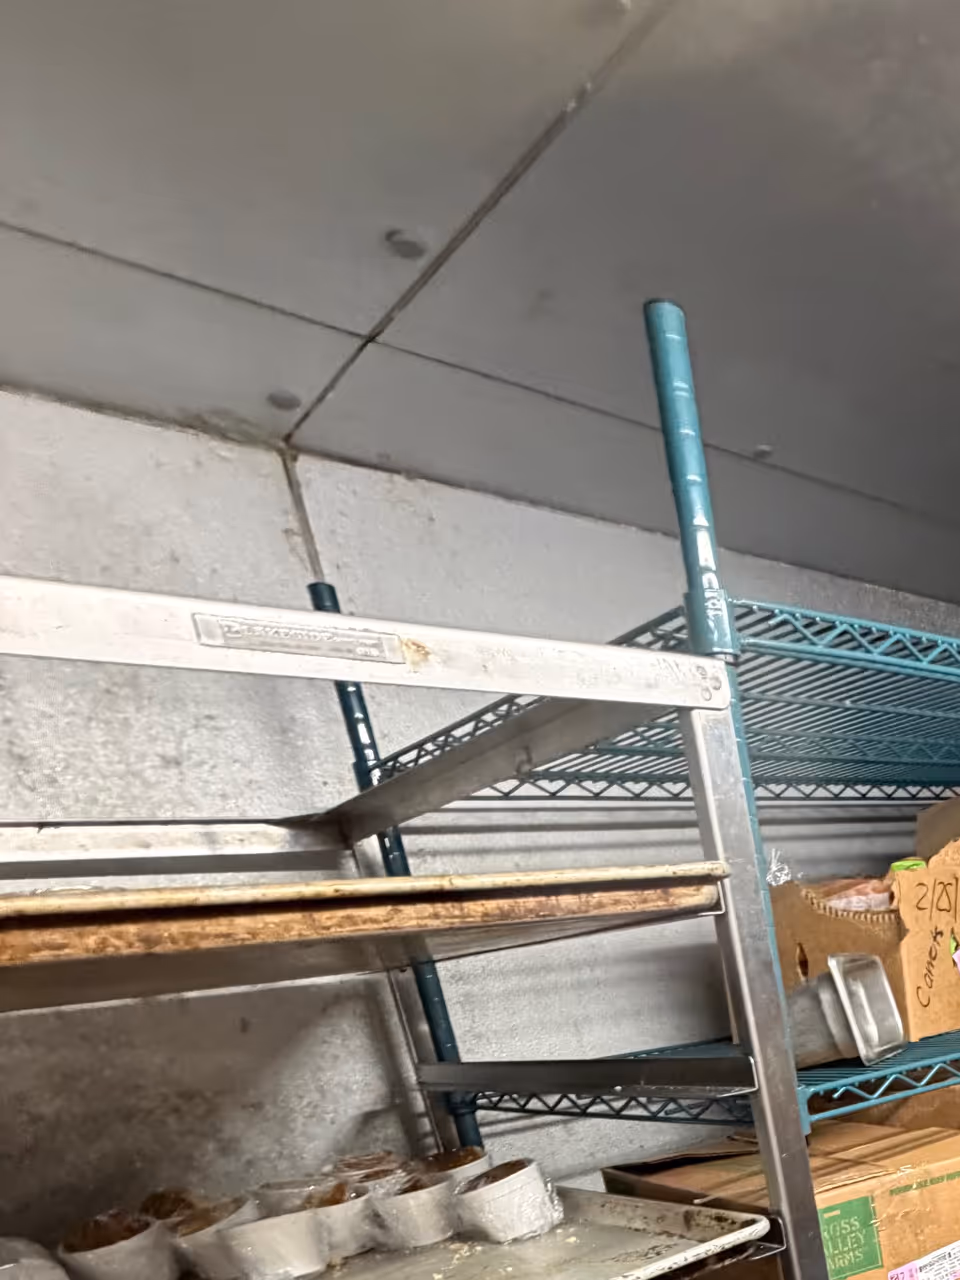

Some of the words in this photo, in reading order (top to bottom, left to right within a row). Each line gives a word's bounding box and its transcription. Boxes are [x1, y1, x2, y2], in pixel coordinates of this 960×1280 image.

[824, 1216, 860, 1239] ROSS
[824, 1229, 866, 1257] LLEY
[827, 1249, 864, 1269] ARMS
